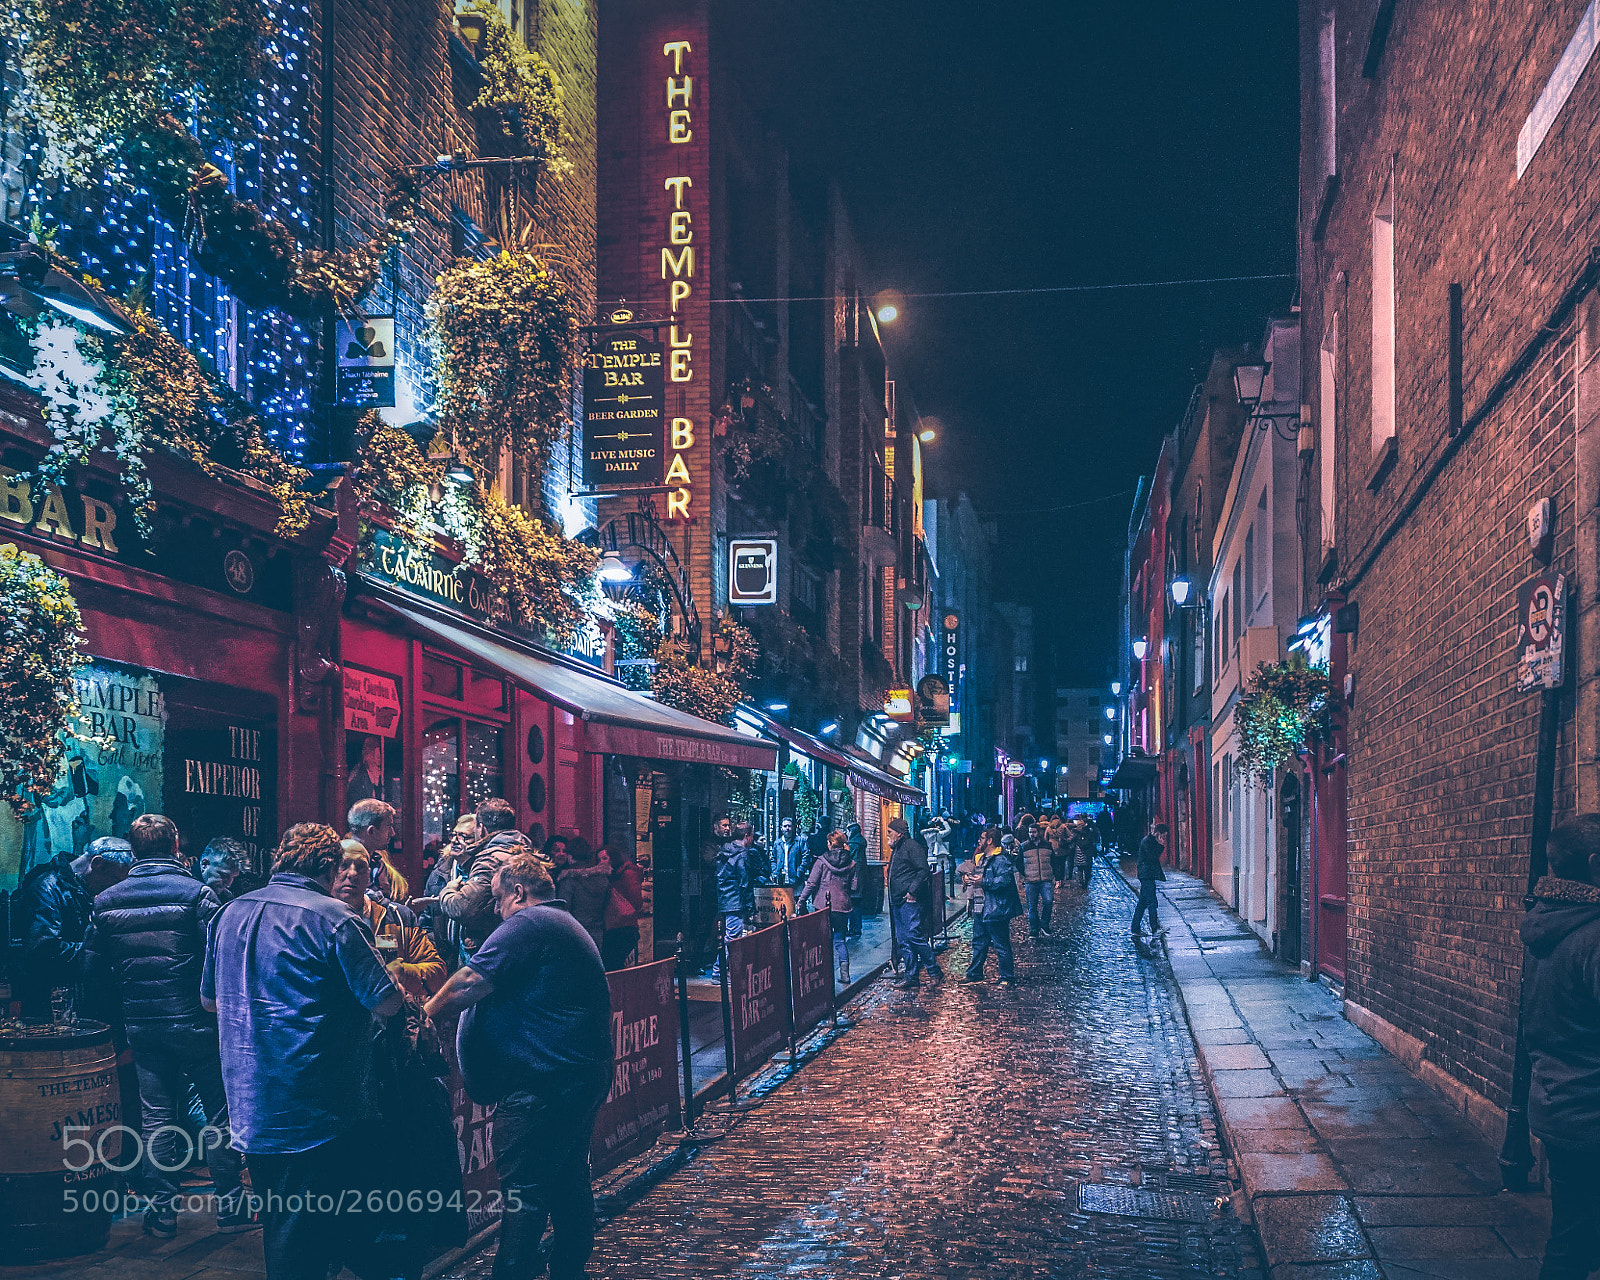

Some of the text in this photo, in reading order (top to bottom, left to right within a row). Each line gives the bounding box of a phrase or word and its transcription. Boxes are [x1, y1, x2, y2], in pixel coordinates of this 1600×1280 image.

[661, 41, 696, 520] THE TEMPLE BAR
[611, 340, 637, 351] THE
[588, 353, 661, 369] TEMPLE
[604, 371, 645, 386] BAR
[588, 408, 659, 421] BEER GARDEN
[590, 448, 656, 460] LIVE MUSIC
[605, 461, 640, 472] DAILY
[0, 465, 119, 553] BAR
[946, 633, 957, 707] HOSTEL
[77, 678, 162, 719] EMPLE
[90, 711, 140, 750] BAR
[229, 726, 261, 761] THE
[656, 737, 675, 756] THE
[185, 759, 261, 799] EMPEROR
[243, 805, 261, 837] OF
[38, 1082, 71, 1097] THE
